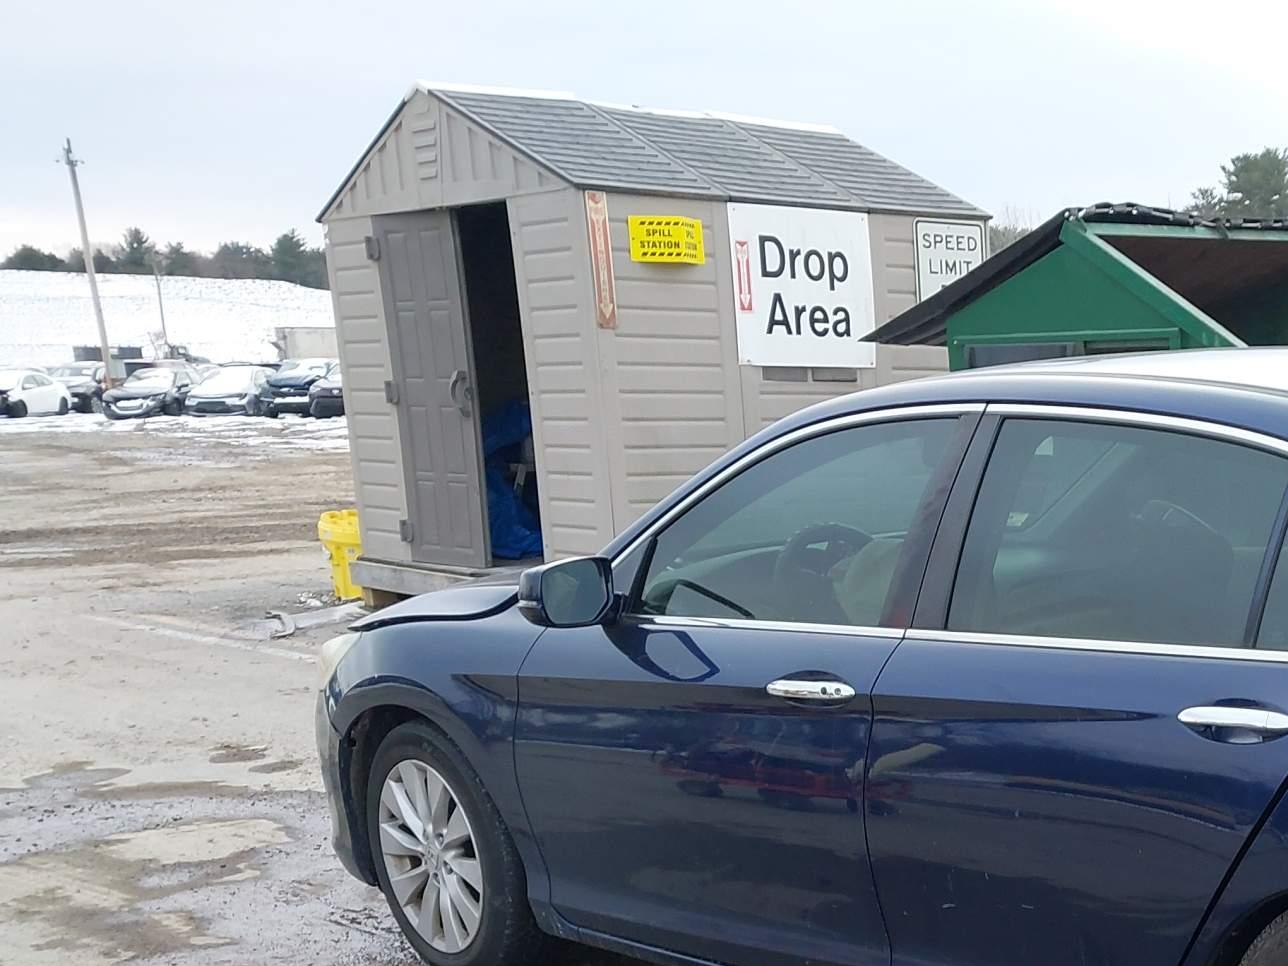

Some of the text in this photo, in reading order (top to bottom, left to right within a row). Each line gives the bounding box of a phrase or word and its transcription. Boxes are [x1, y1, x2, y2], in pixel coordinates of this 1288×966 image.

[645, 228, 673, 237] SPILL
[922, 232, 978, 252] SPEED
[639, 240, 681, 250] STATION
[758, 235, 850, 292] Drop
[928, 258, 973, 276] LIMIT
[766, 292, 852, 338] Area
